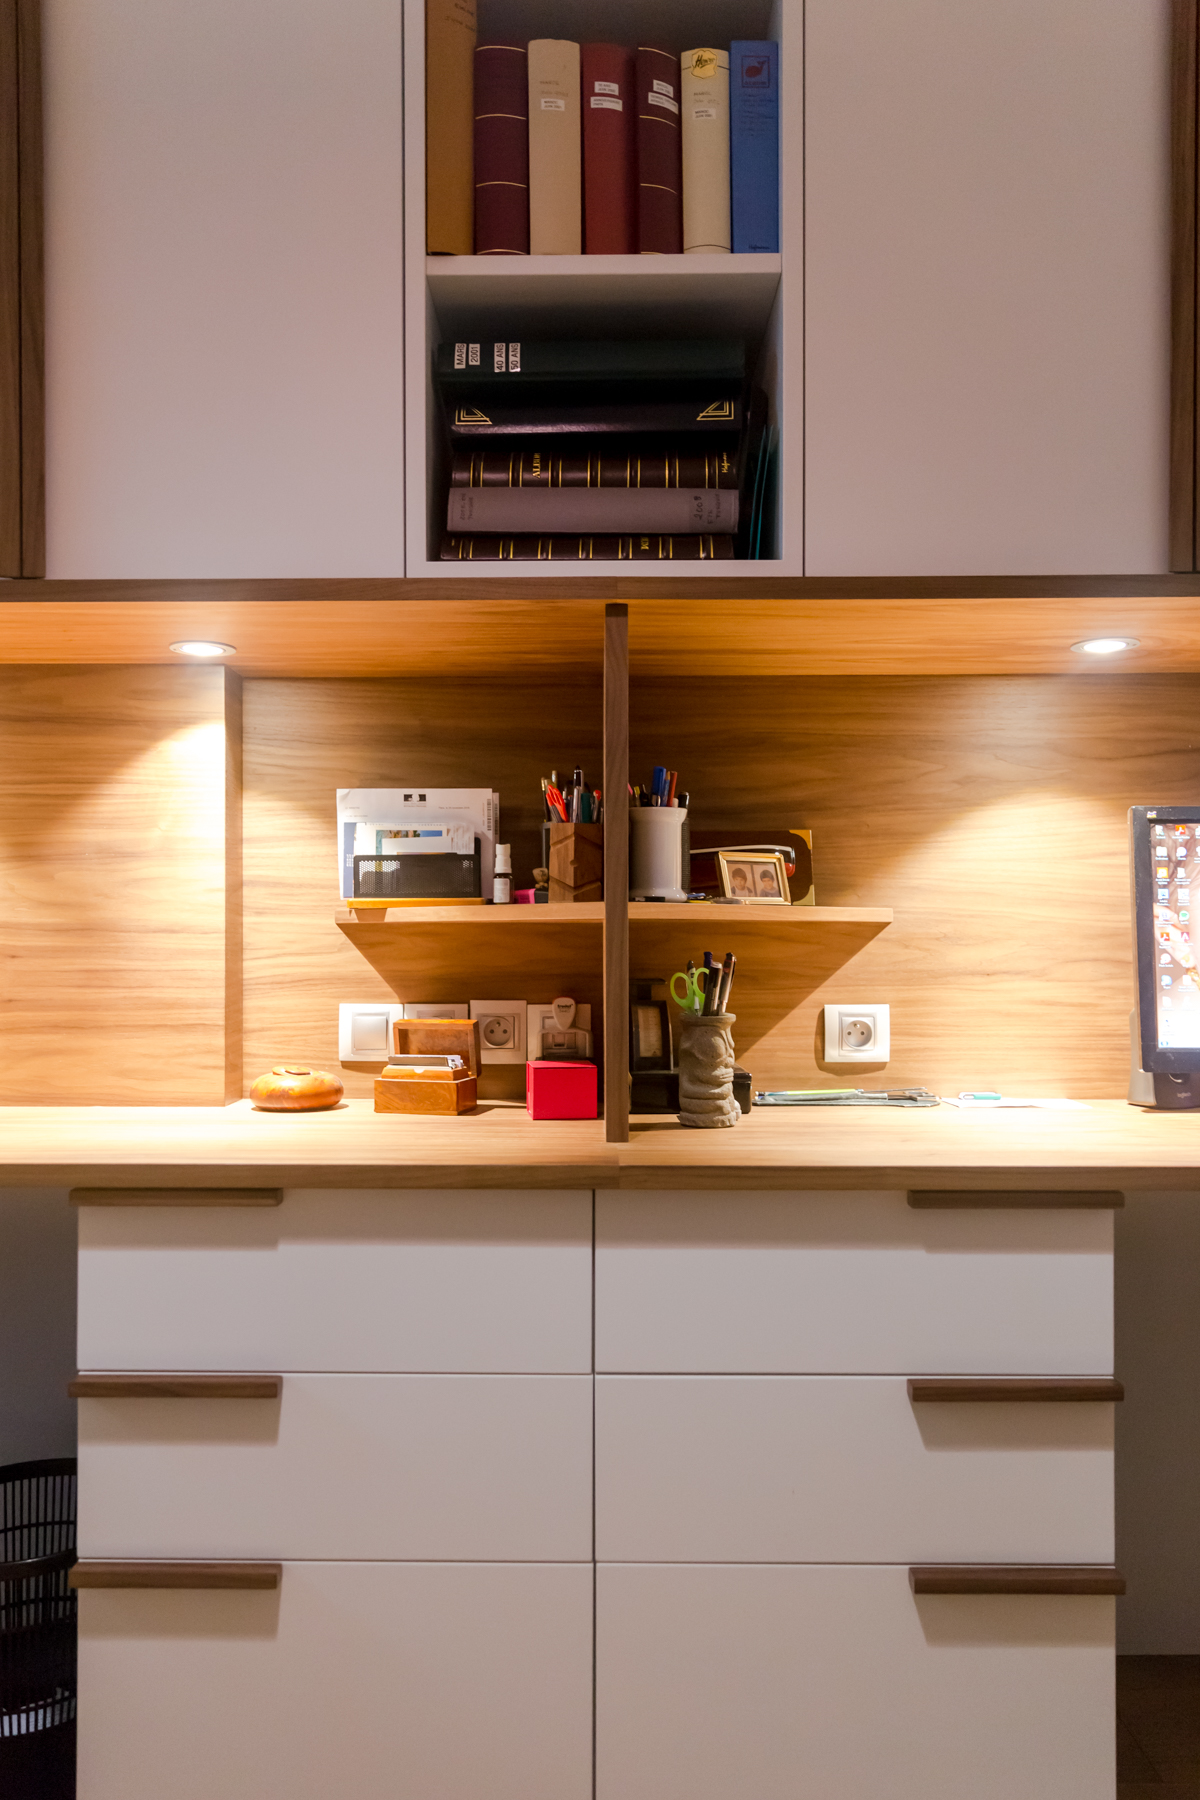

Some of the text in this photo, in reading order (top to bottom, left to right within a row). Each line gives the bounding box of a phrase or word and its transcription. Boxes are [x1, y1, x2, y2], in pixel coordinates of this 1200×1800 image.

[456, 343, 465, 366] MARS
[470, 346, 478, 363] 2001
[496, 344, 504, 371] 40 ANS
[510, 343, 519, 370] 50 ANS
[693, 496, 703, 520] 2008
